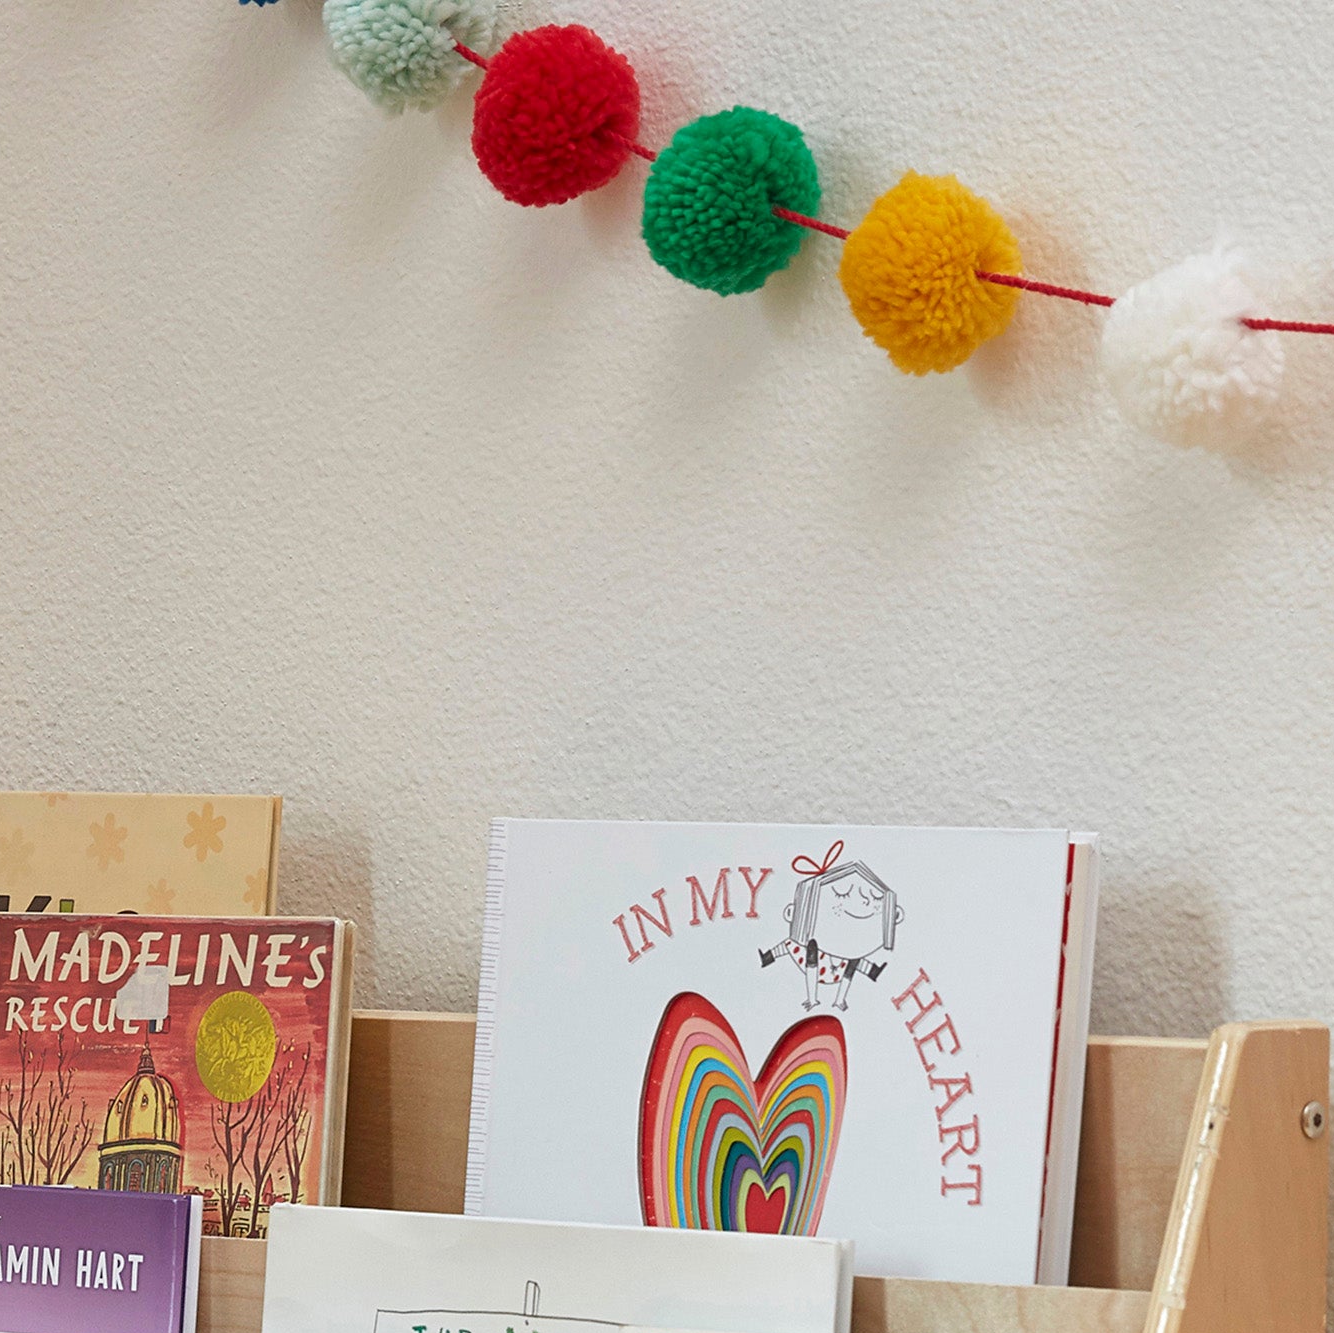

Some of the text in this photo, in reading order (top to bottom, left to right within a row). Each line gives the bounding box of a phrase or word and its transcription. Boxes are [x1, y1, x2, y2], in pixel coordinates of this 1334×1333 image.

[613, 866, 773, 963] IN MY
[891, 968, 983, 1208] HEART
[75, 1248, 144, 1292] HART
